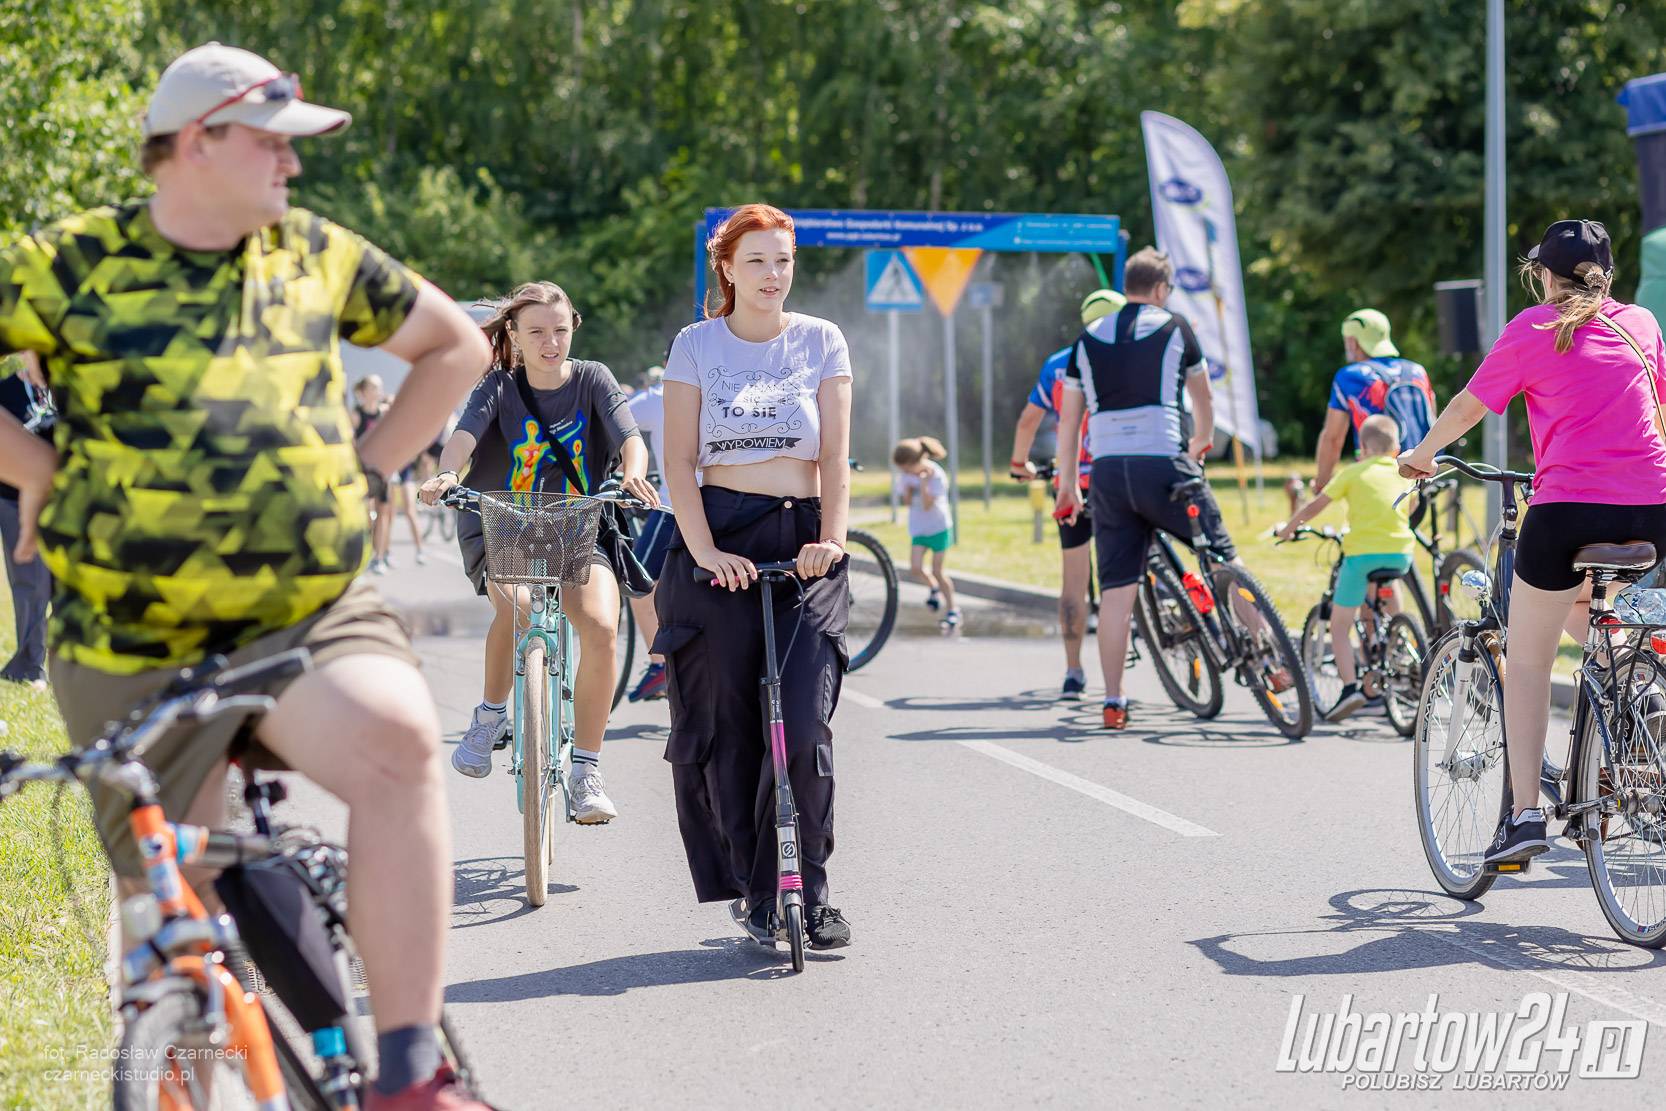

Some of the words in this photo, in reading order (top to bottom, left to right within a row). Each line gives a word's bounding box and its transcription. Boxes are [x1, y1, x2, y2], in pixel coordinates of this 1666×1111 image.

[721, 380, 741, 392] NIE
[722, 406, 745, 418] TO
[716, 437, 787, 451] WYPOWIEM
